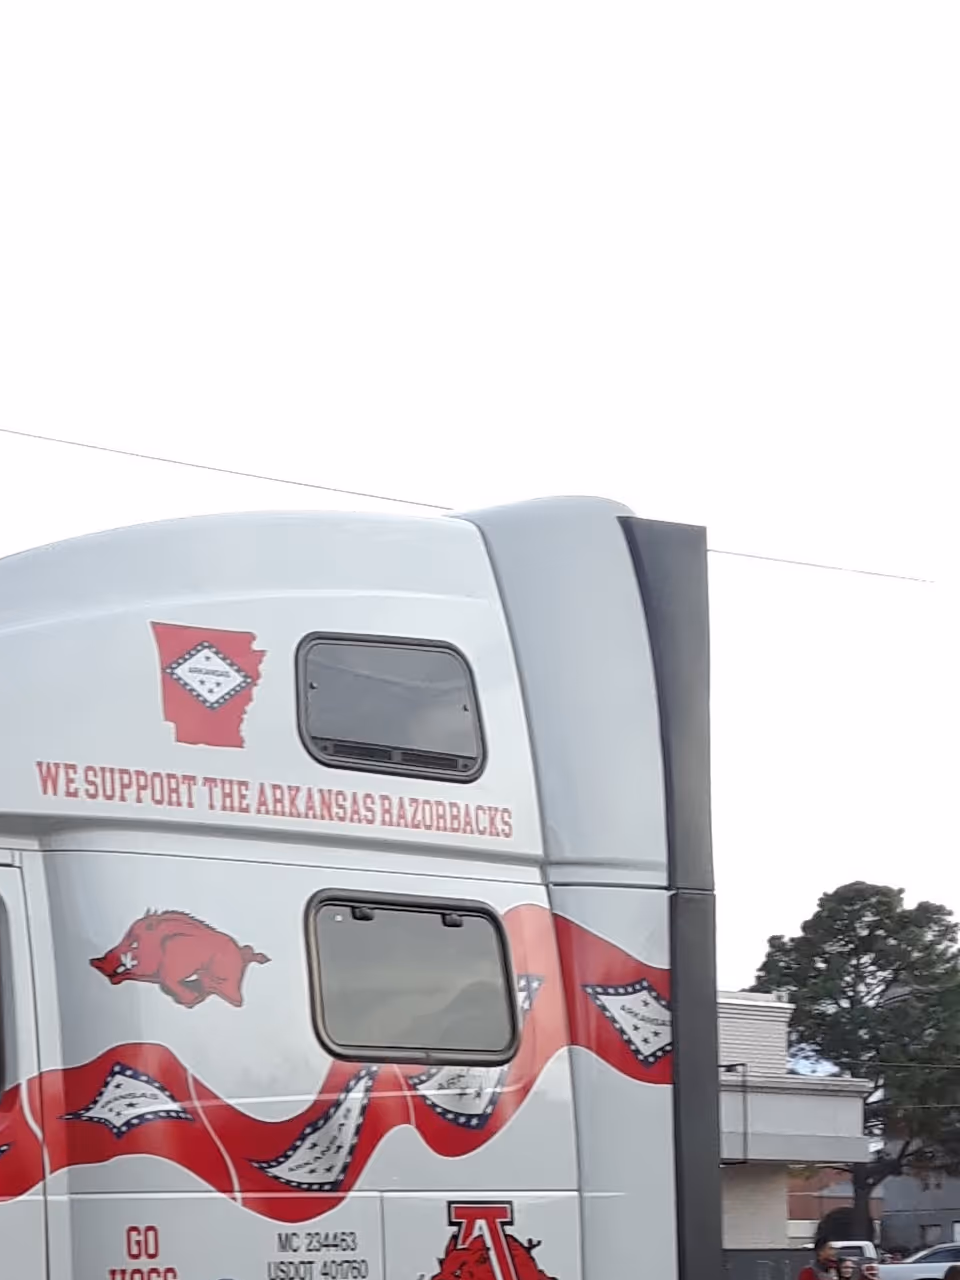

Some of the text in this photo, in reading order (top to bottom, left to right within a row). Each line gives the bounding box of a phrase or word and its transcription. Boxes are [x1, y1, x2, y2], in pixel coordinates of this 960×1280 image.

[36, 761, 514, 838] WE SUPPORT THE ARKANSAS RAZORBACKS
[126, 1225, 160, 1260] GO
[277, 1231, 358, 1252] MC 234463
[267, 1259, 369, 1280] USDOT 401760
